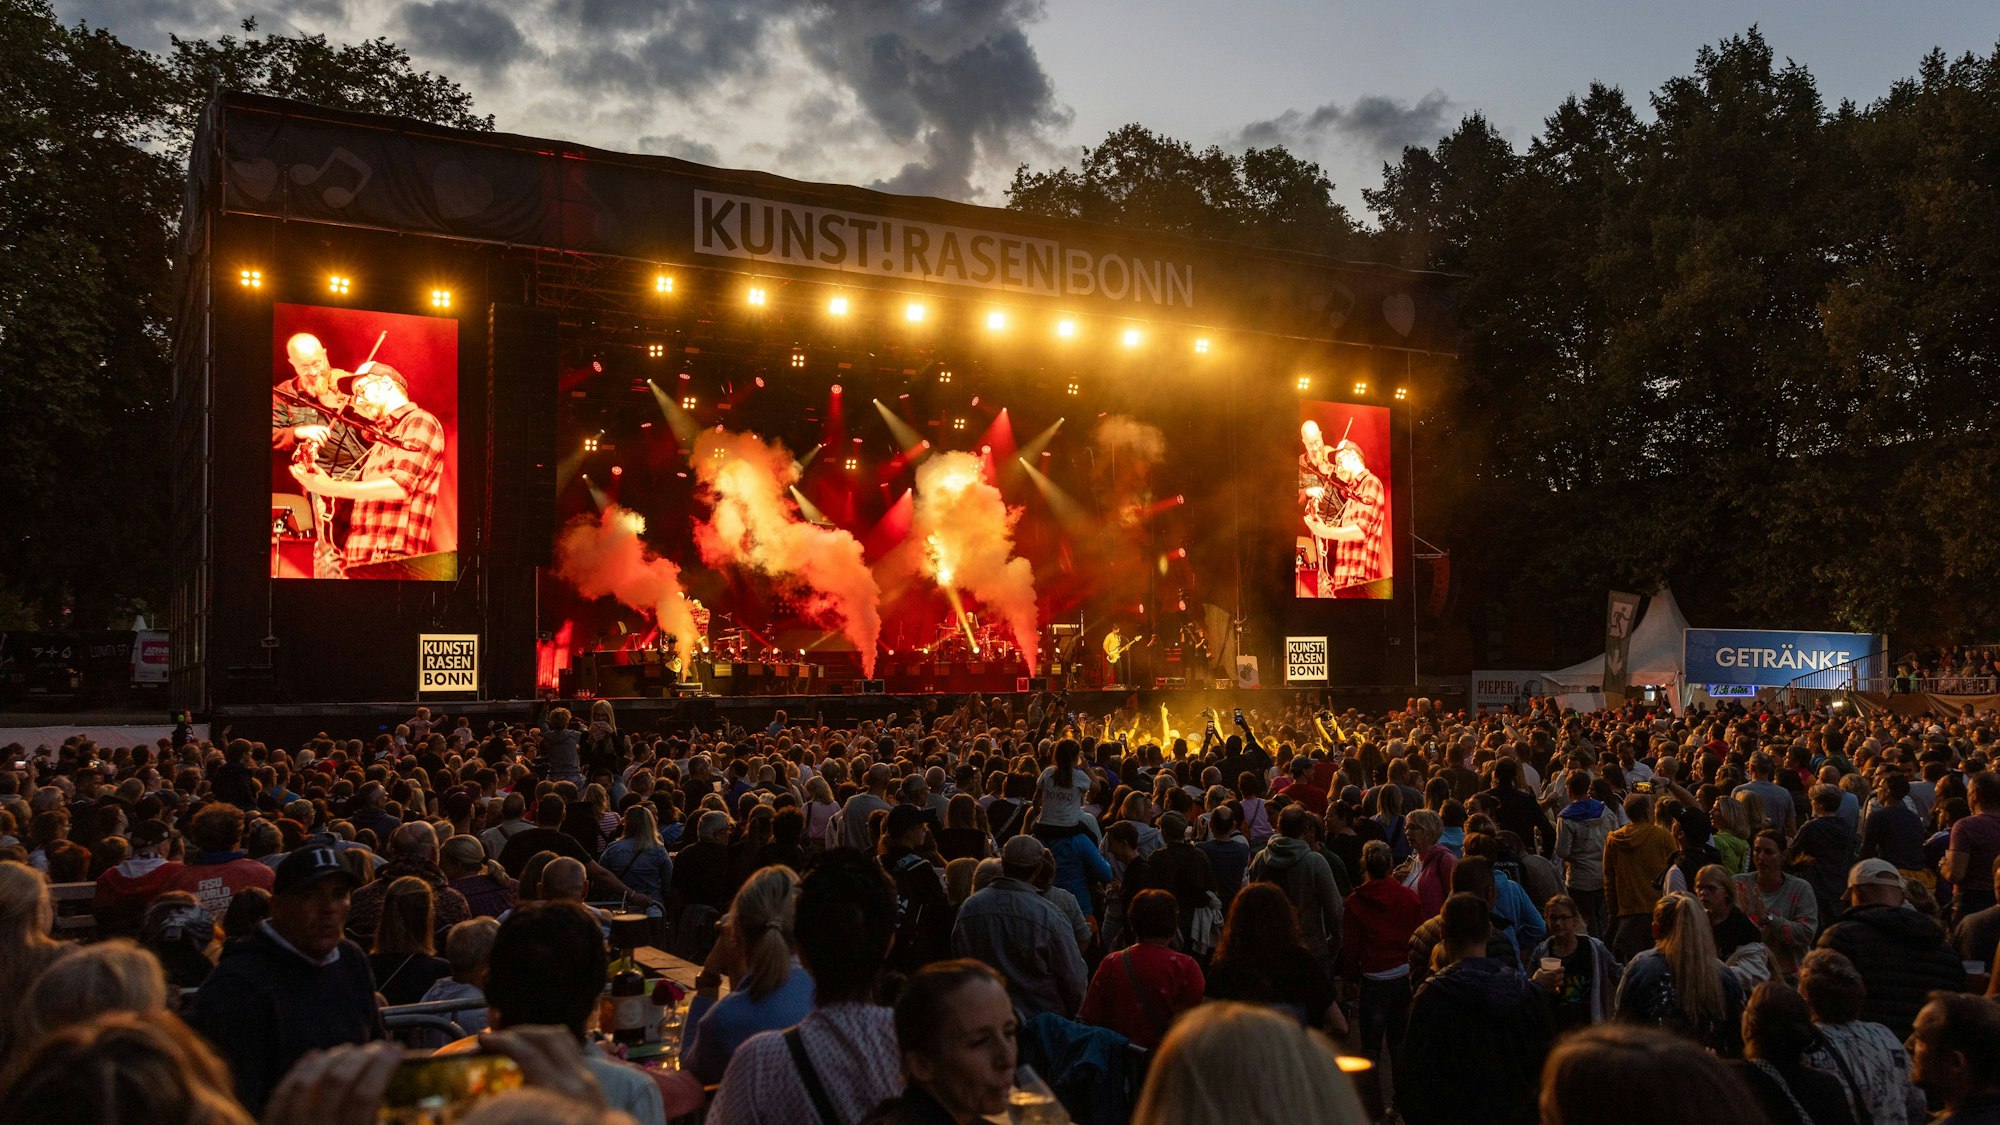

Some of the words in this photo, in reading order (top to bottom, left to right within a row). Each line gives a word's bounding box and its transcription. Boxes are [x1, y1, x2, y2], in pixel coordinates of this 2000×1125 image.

[1065, 249, 1193, 308] BONN
[424, 641, 473, 655] KUNST!
[1290, 642, 1324, 652] KUNST!
[426, 656, 471, 669] RASEN
[1291, 653, 1323, 663] RASEN
[1715, 643, 1850, 671] GETRÄNKE
[1290, 666, 1324, 676] BONN
[424, 672, 473, 685] BONN
[198, 876, 223, 891] FISU
